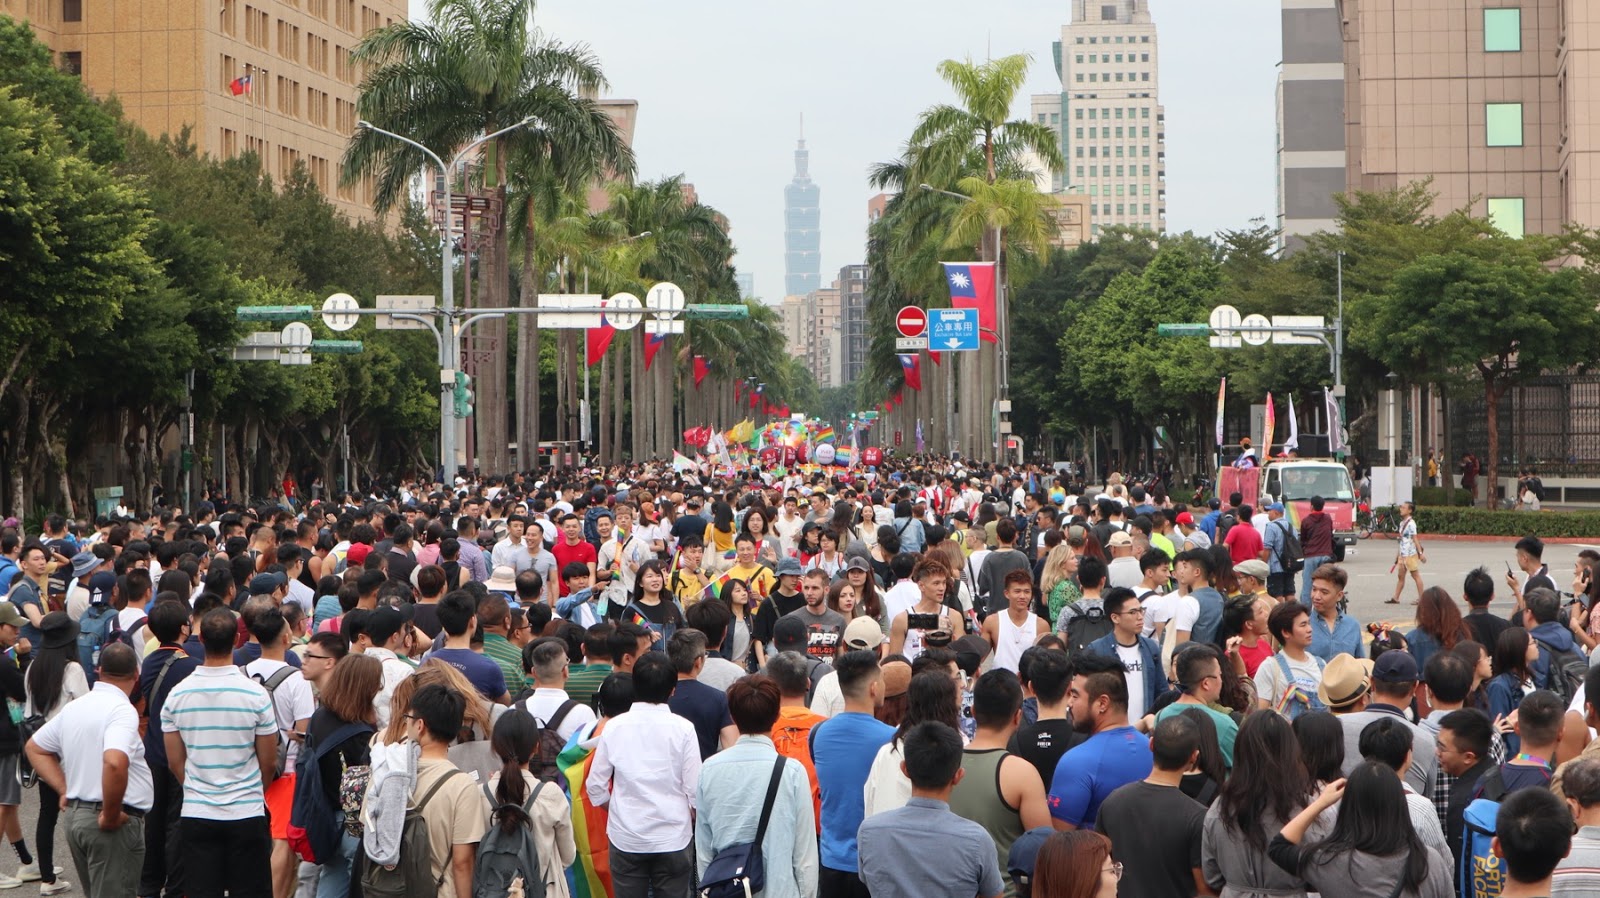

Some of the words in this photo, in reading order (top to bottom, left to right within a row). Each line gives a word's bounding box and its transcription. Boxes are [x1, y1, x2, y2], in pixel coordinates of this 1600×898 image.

[934, 322, 973, 332] 公車專用
[807, 632, 838, 645] UPER
